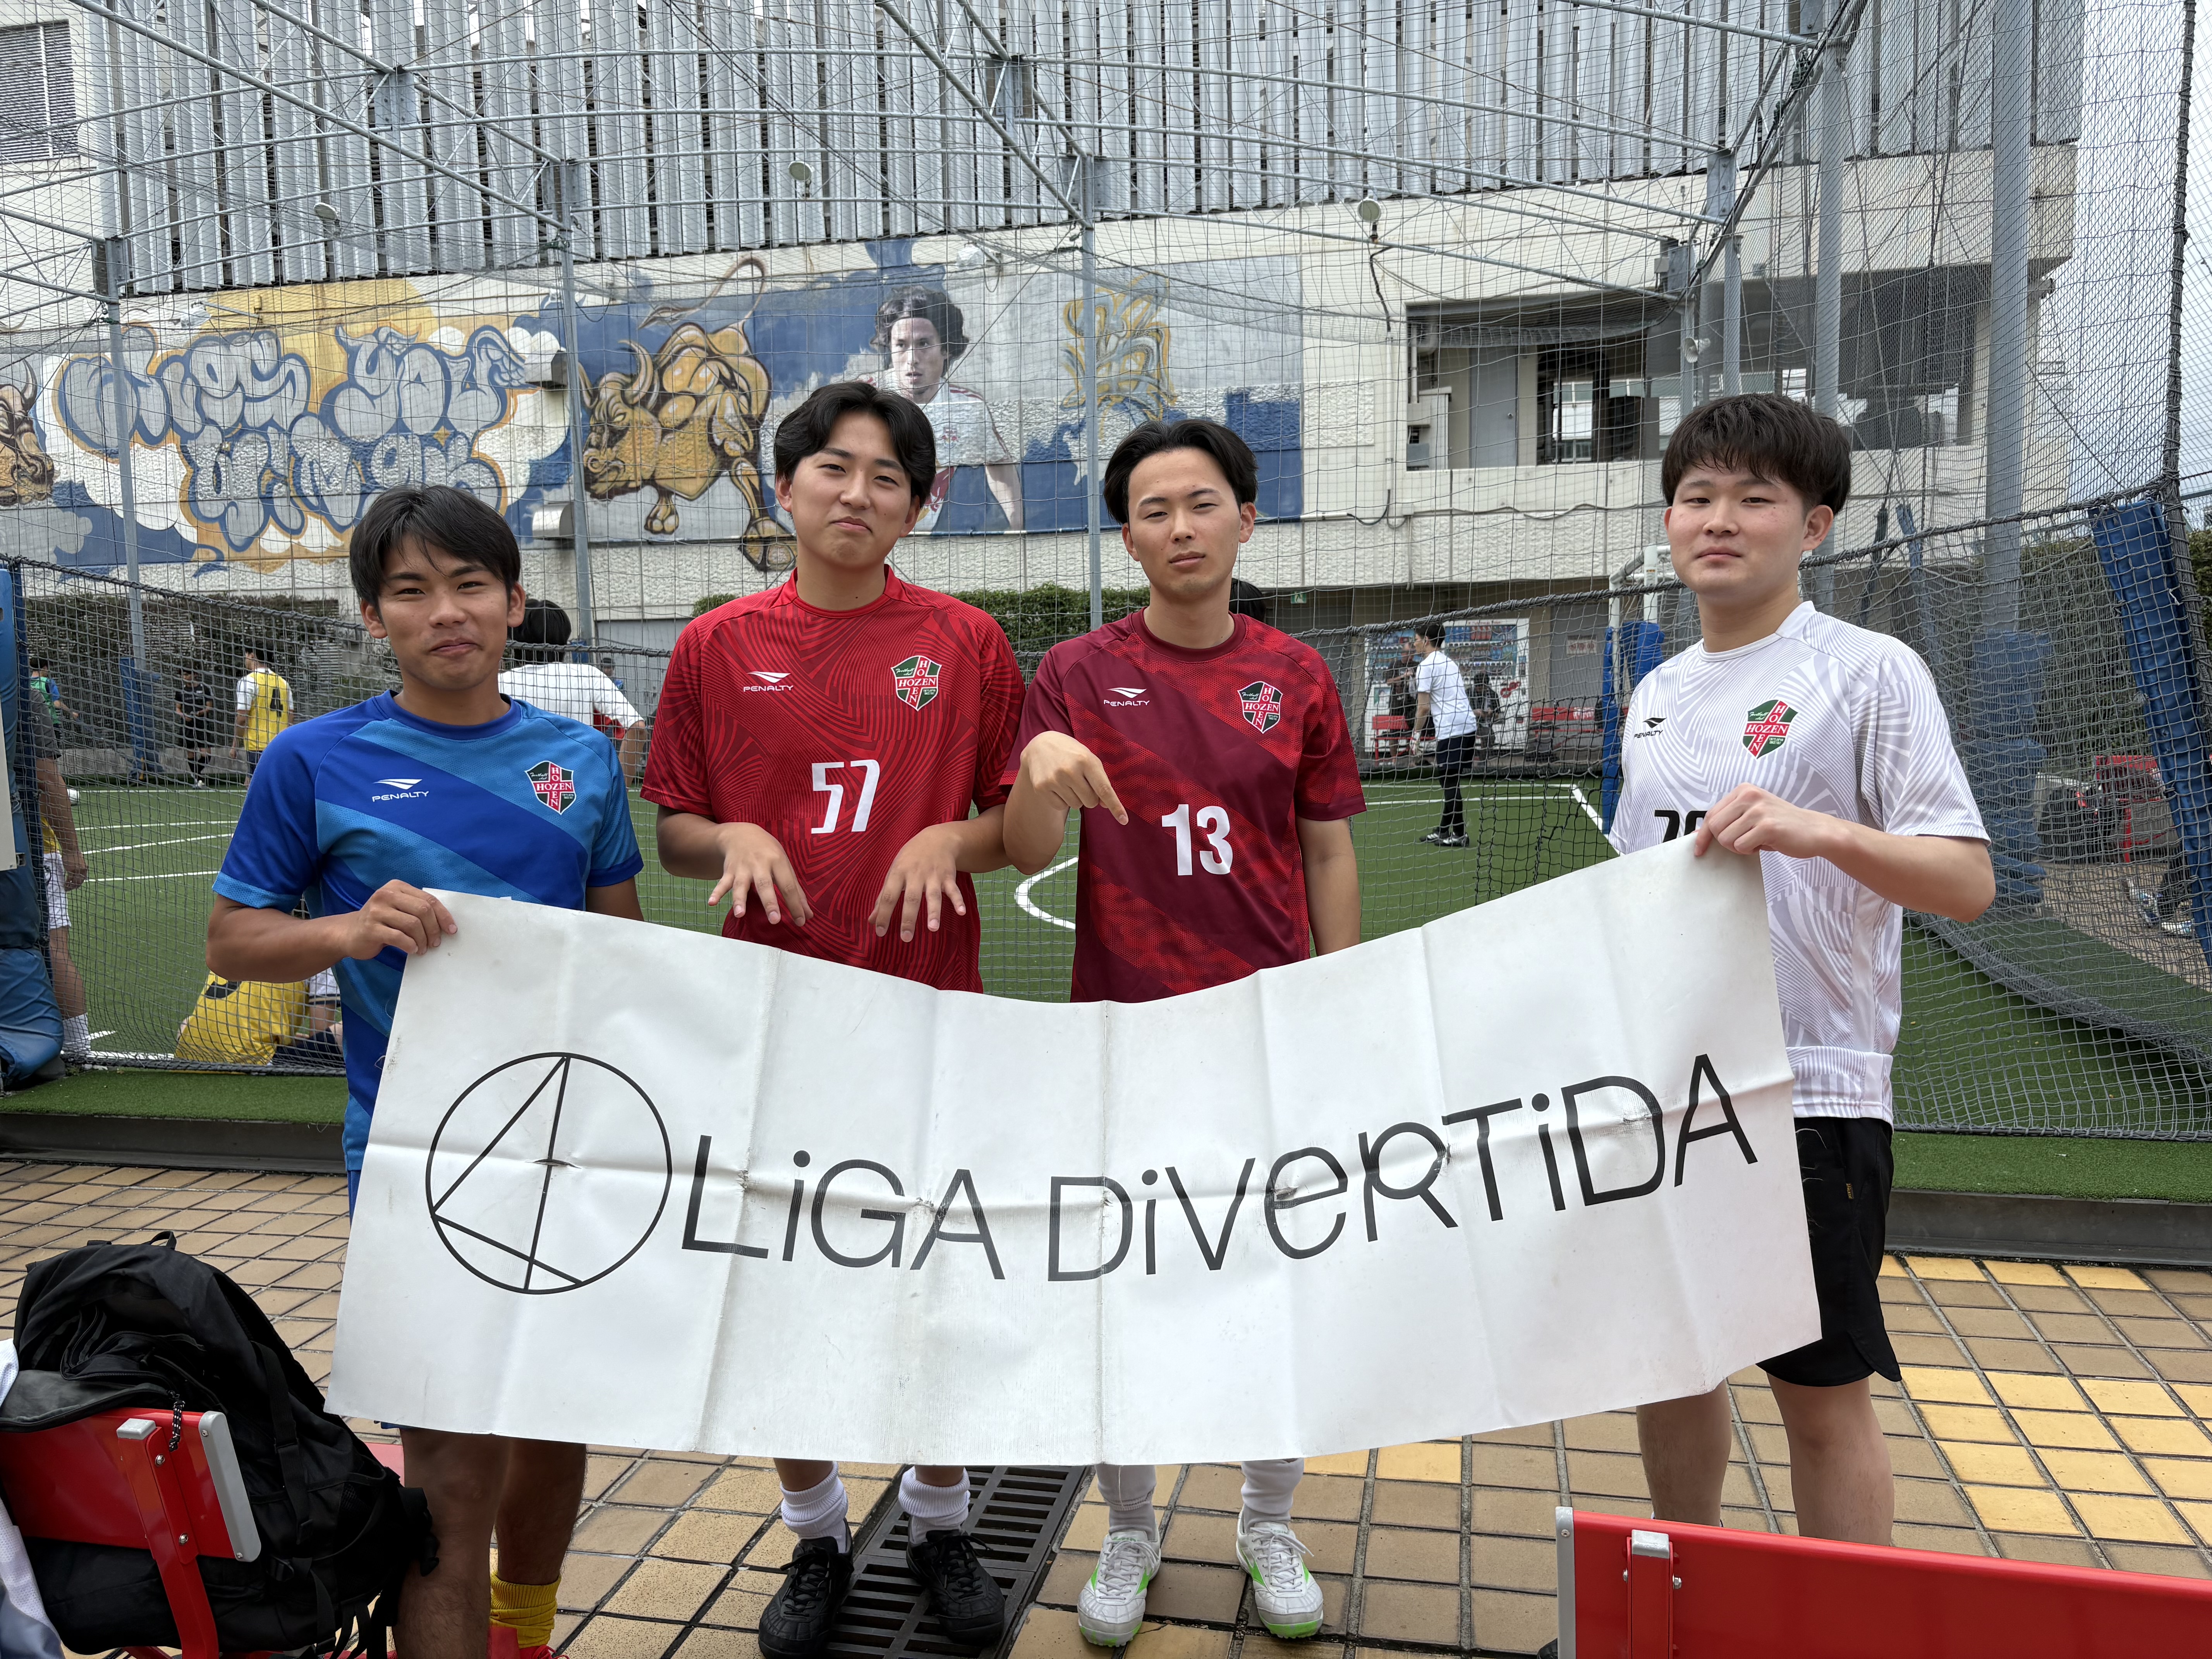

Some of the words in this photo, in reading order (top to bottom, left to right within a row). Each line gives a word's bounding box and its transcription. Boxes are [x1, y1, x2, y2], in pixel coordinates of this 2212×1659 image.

[898, 678, 936, 687] HOZEN
[270, 689, 283, 716] 4
[1245, 703, 1279, 711] HOZEN
[1634, 730, 1663, 738] PENALTY
[1746, 725, 1788, 734] HOZEN
[372, 791, 429, 802] PENALTY
[811, 759, 880, 834] 57
[1161, 804, 1233, 876] 13
